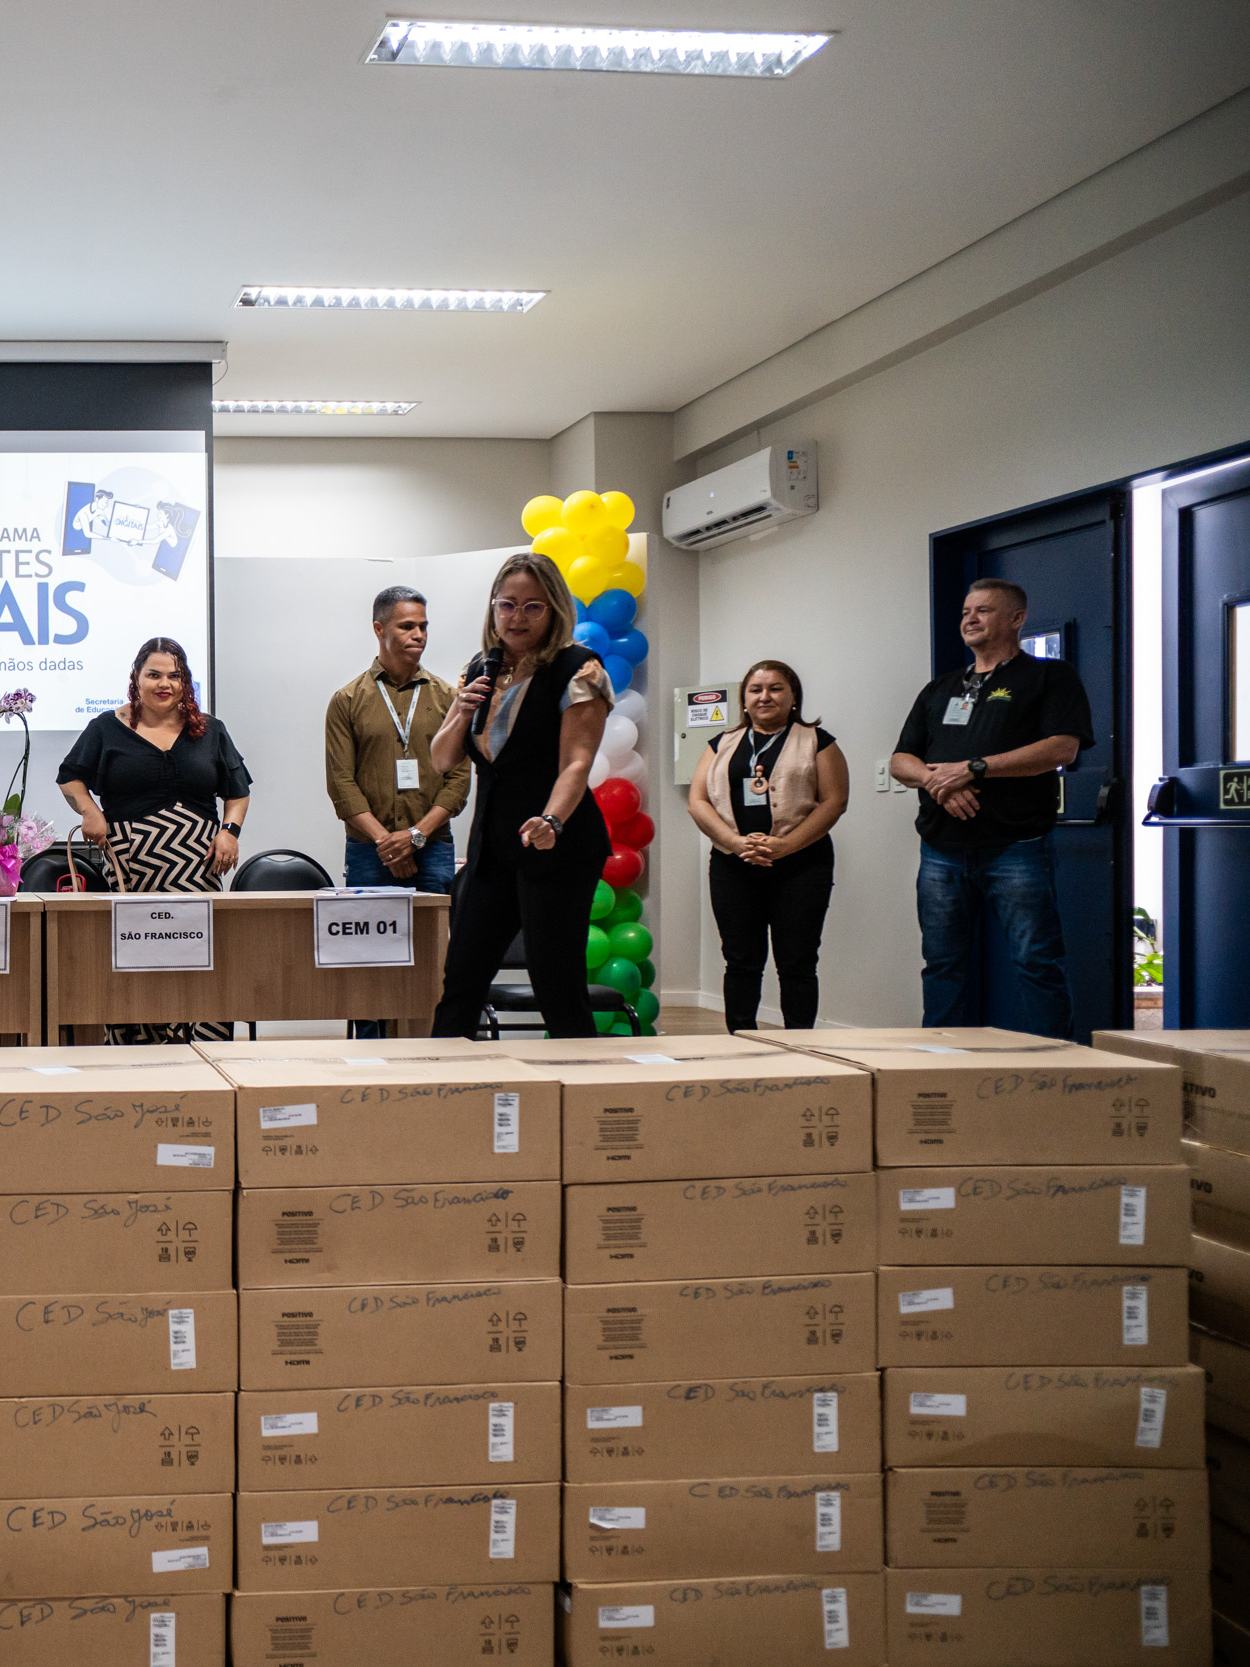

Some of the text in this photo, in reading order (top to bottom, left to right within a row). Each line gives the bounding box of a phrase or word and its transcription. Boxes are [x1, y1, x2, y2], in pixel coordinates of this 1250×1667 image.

[38, 657, 84, 672] dadas
[150, 911, 174, 920] CED.
[120, 930, 203, 941] SÃO FRANCISCO
[327, 920, 399, 936] CEM 01
[665, 1085, 710, 1101] CED
[329, 1190, 384, 1214] CED
[9, 1199, 69, 1226] CED
[15, 1301, 85, 1331] CED
[91, 1301, 137, 1326] São
[667, 1383, 716, 1402] CED
[14, 1402, 63, 1428] CED
[6, 1500, 176, 1538] CED São José
